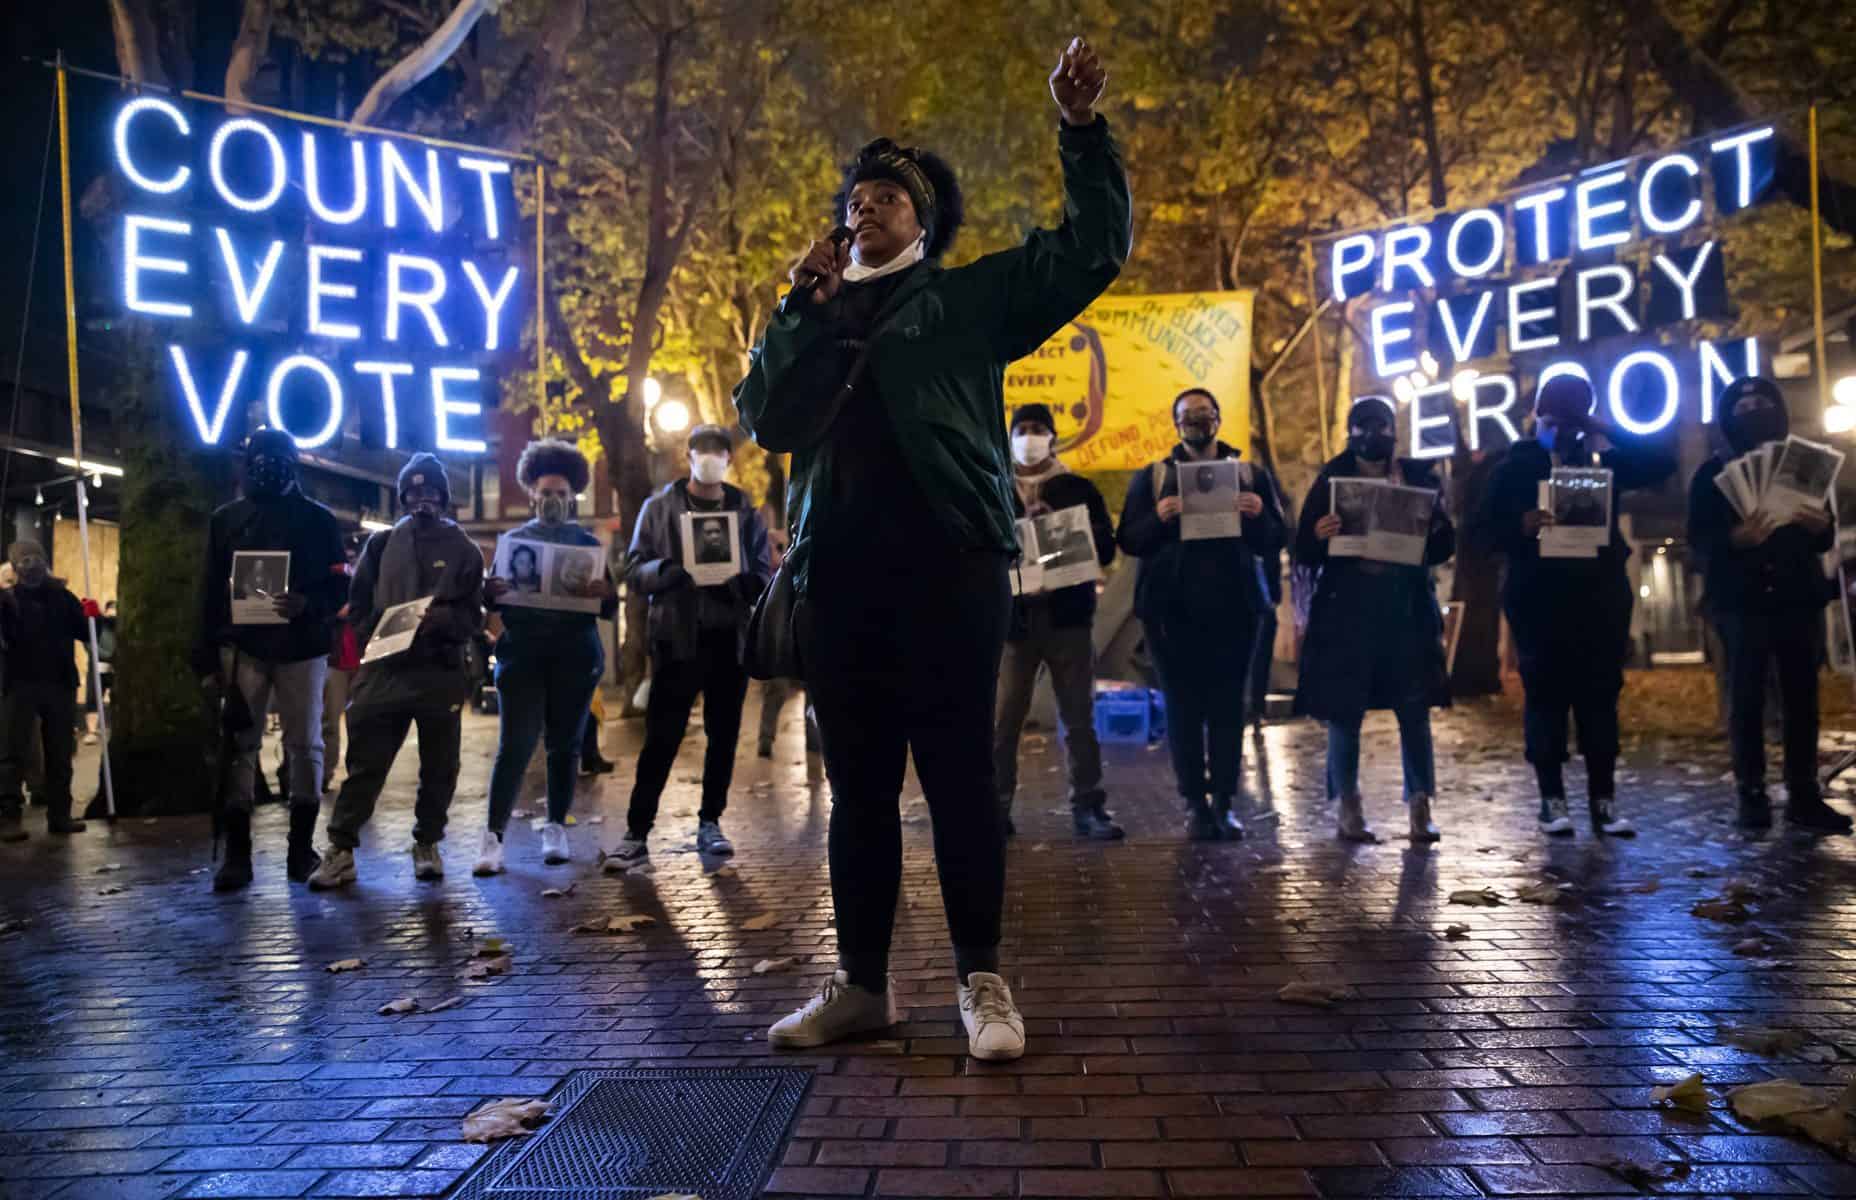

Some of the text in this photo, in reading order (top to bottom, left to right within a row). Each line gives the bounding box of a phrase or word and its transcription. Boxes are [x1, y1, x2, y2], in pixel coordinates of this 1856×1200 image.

[113, 97, 511, 240] COUNT
[1331, 127, 1775, 301] PROTECT
[123, 215, 520, 350] EVERY
[1370, 240, 1713, 377] EVERY
[168, 345, 487, 452] VOTE
[1007, 374, 1056, 387] EVERY
